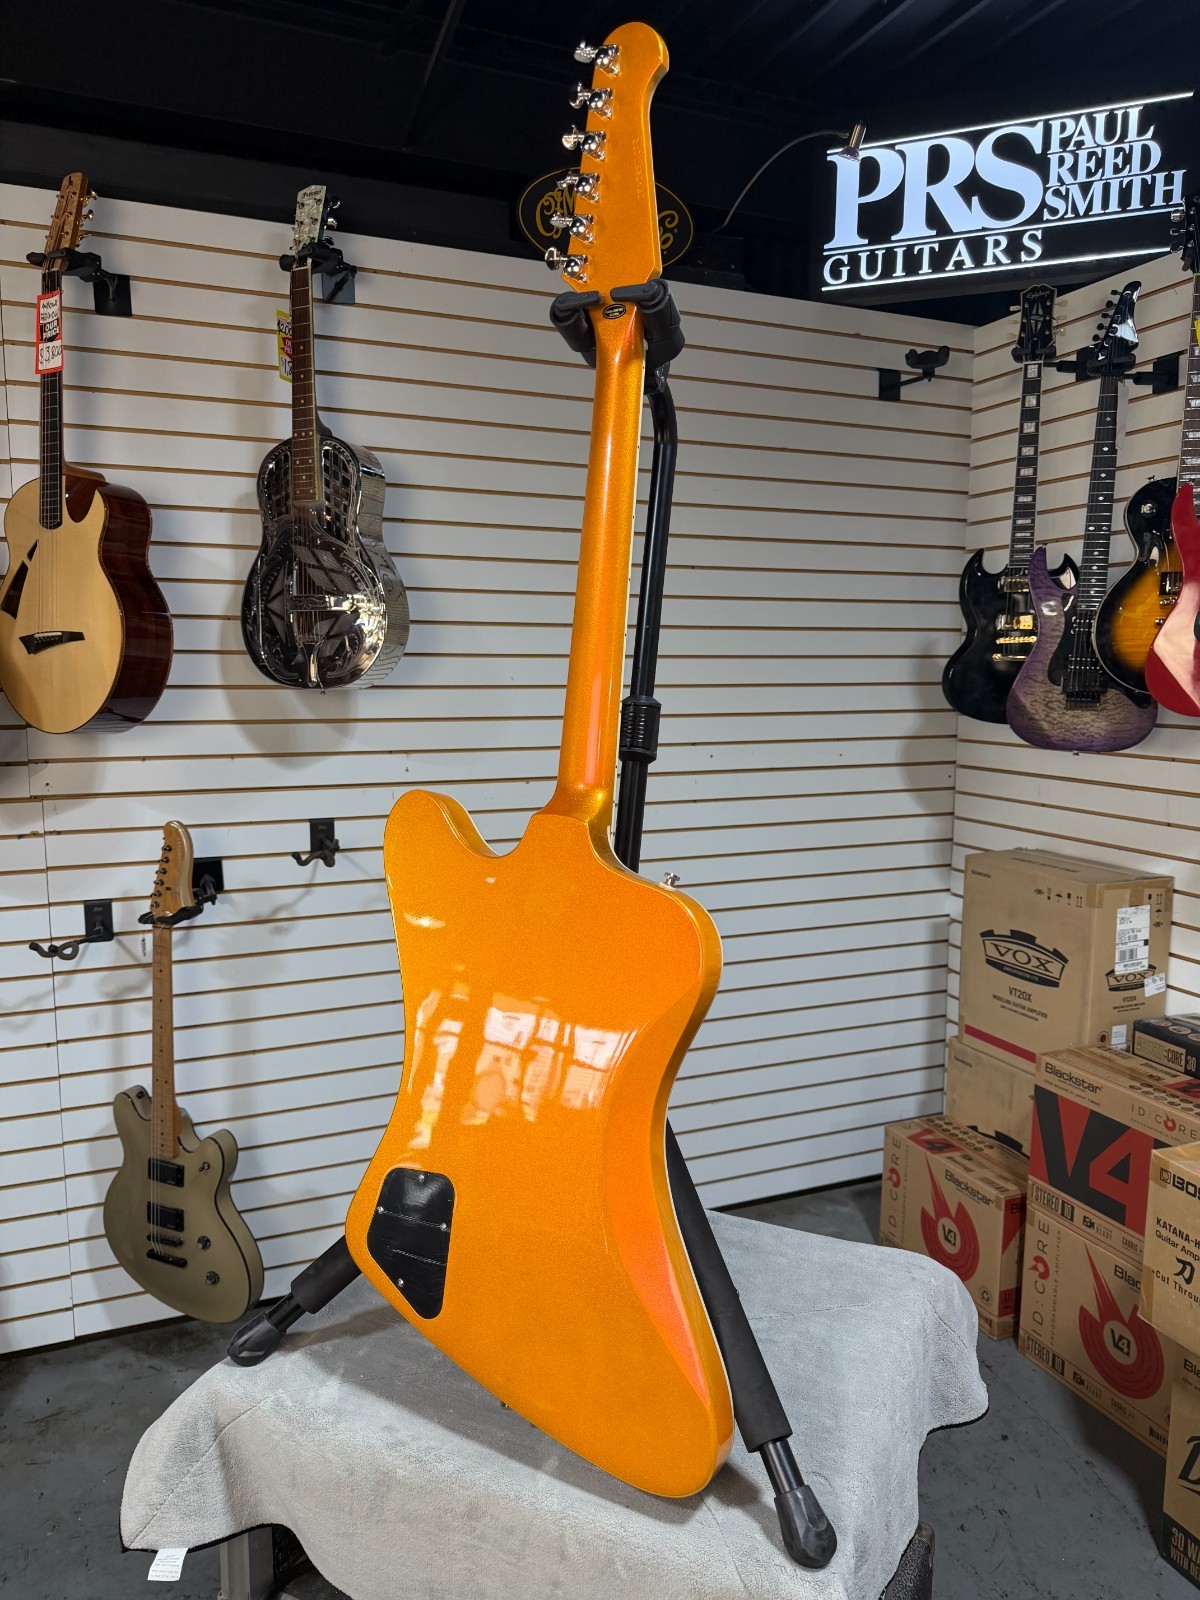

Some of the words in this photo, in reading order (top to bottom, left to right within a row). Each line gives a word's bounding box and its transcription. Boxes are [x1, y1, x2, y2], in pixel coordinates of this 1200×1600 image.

[1047, 106, 1155, 154] PAUL
[1046, 140, 1162, 187] REED
[824, 121, 1044, 249] PRS
[1043, 169, 1187, 221] SMITH
[823, 229, 1043, 285] GUITARS
[43, 326, 60, 341] PRICE
[45, 320, 58, 331] OUR
[990, 942, 1054, 974] VOX
[1112, 971, 1149, 983] VOX
[1008, 985, 1033, 1003] VT20X
[1044, 1062, 1102, 1094] Blackstar
[1187, 1055, 1197, 1072] 30
[945, 1169, 994, 1207] Blackstar
[1034, 1185, 1060, 1213] STEREO
[1062, 1202, 1073, 1221] 10
[1155, 1229, 1179, 1250] Guitar
[1026, 1337, 1050, 1364] STEREO
[1171, 1527, 1185, 1551] 30
[1170, 1544, 1189, 1571] WITH
